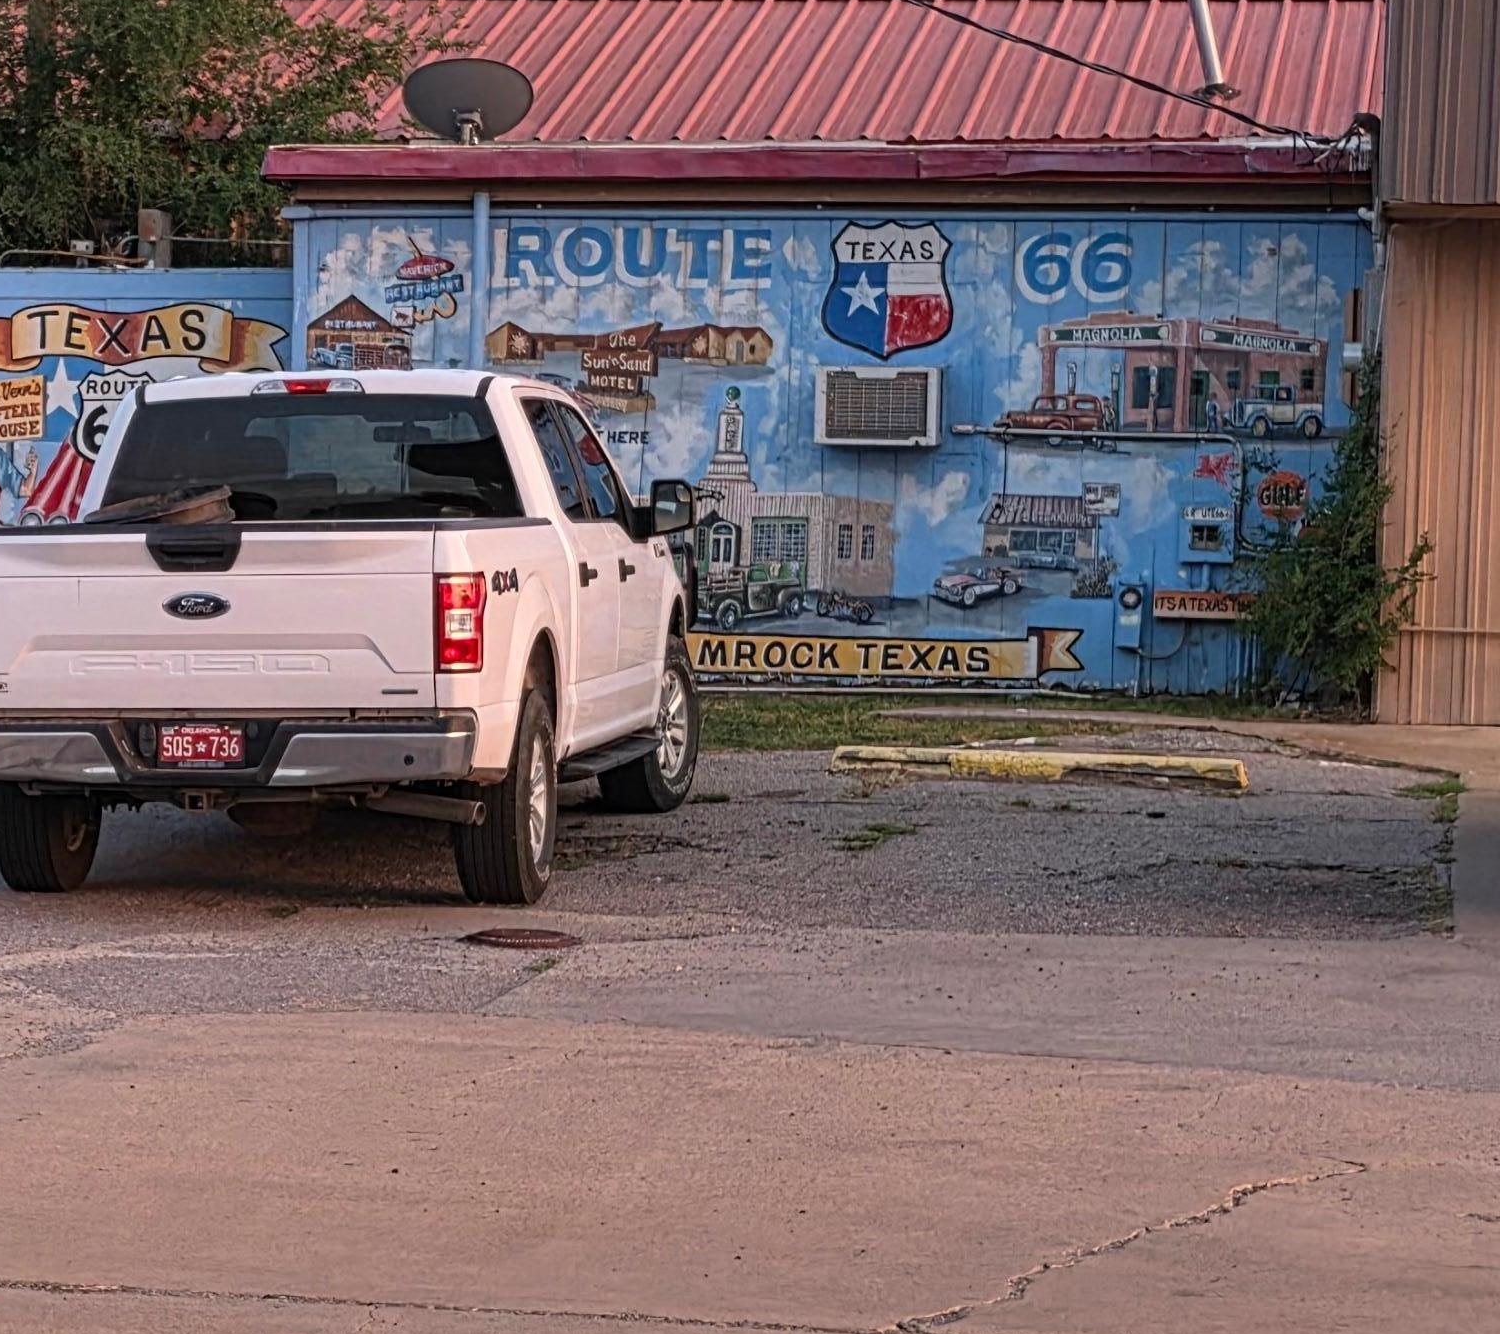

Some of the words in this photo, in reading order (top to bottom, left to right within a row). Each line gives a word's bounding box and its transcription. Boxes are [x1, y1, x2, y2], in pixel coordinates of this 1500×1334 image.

[494, 226, 772, 289] ROUTE
[844, 239, 935, 261] TEXAS
[1014, 232, 1134, 304] 66
[26, 310, 207, 356] TEXAS
[609, 333, 637, 348] The
[1071, 327, 1143, 342] MAGNOLIA
[1232, 335, 1297, 352] MAGNOLIA
[590, 375, 635, 390] MOTEL
[607, 430, 650, 445] HERE
[176, 596, 214, 614] Ford
[1189, 597, 1228, 612] TEXAS
[69, 654, 331, 675] F-150
[856, 642, 990, 672] TEXAS
